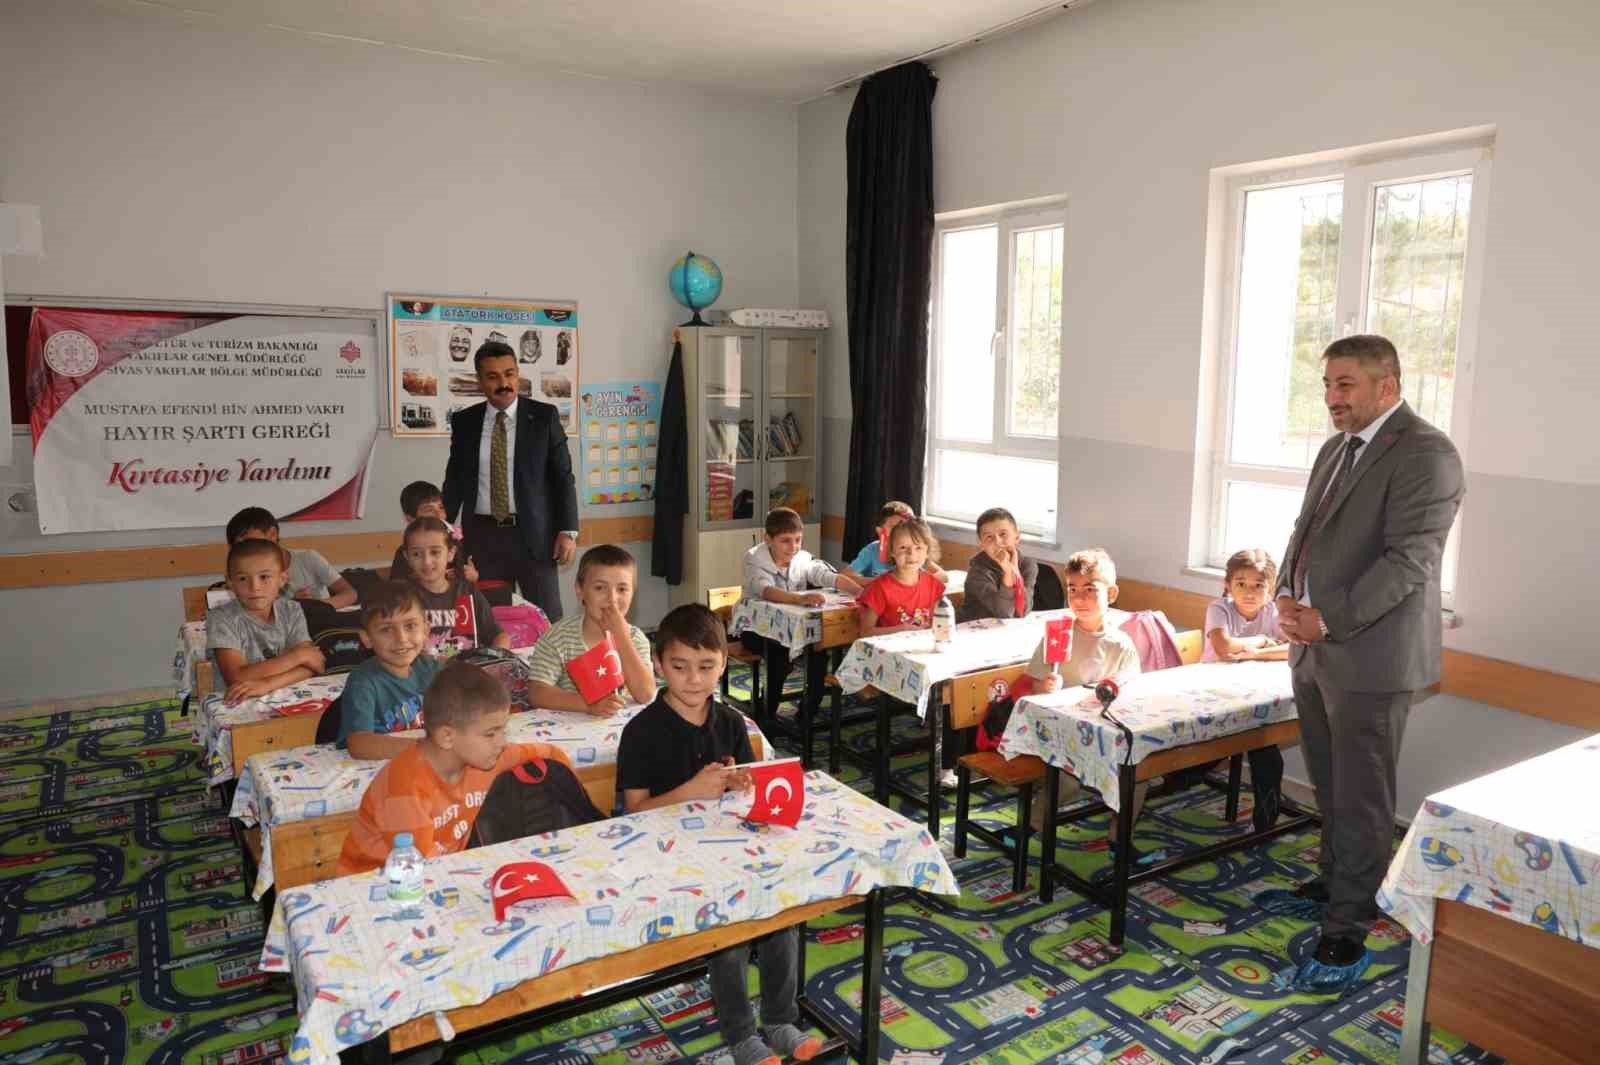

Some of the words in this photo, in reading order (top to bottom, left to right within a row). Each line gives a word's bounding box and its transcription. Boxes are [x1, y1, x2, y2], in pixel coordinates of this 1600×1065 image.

[209, 338, 253, 350] TURİZM
[257, 339, 318, 351] BAKANLIĞI
[192, 353, 228, 362] GENEL
[145, 366, 205, 376] VAKIFLAR
[84, 404, 157, 416] MUSTAFA
[162, 403, 217, 416] EFENDİ
[222, 403, 247, 415] BİN
[252, 404, 302, 415] AHMED
[306, 404, 345, 415] VAKFI
[104, 426, 176, 441] HAYIR
[182, 425, 245, 443] ŞARTI
[252, 421, 331, 439] GEREĞİ
[106, 458, 229, 492] Kırtasiye
[236, 458, 332, 481] Yardımı
[433, 804, 460, 829] BEST
